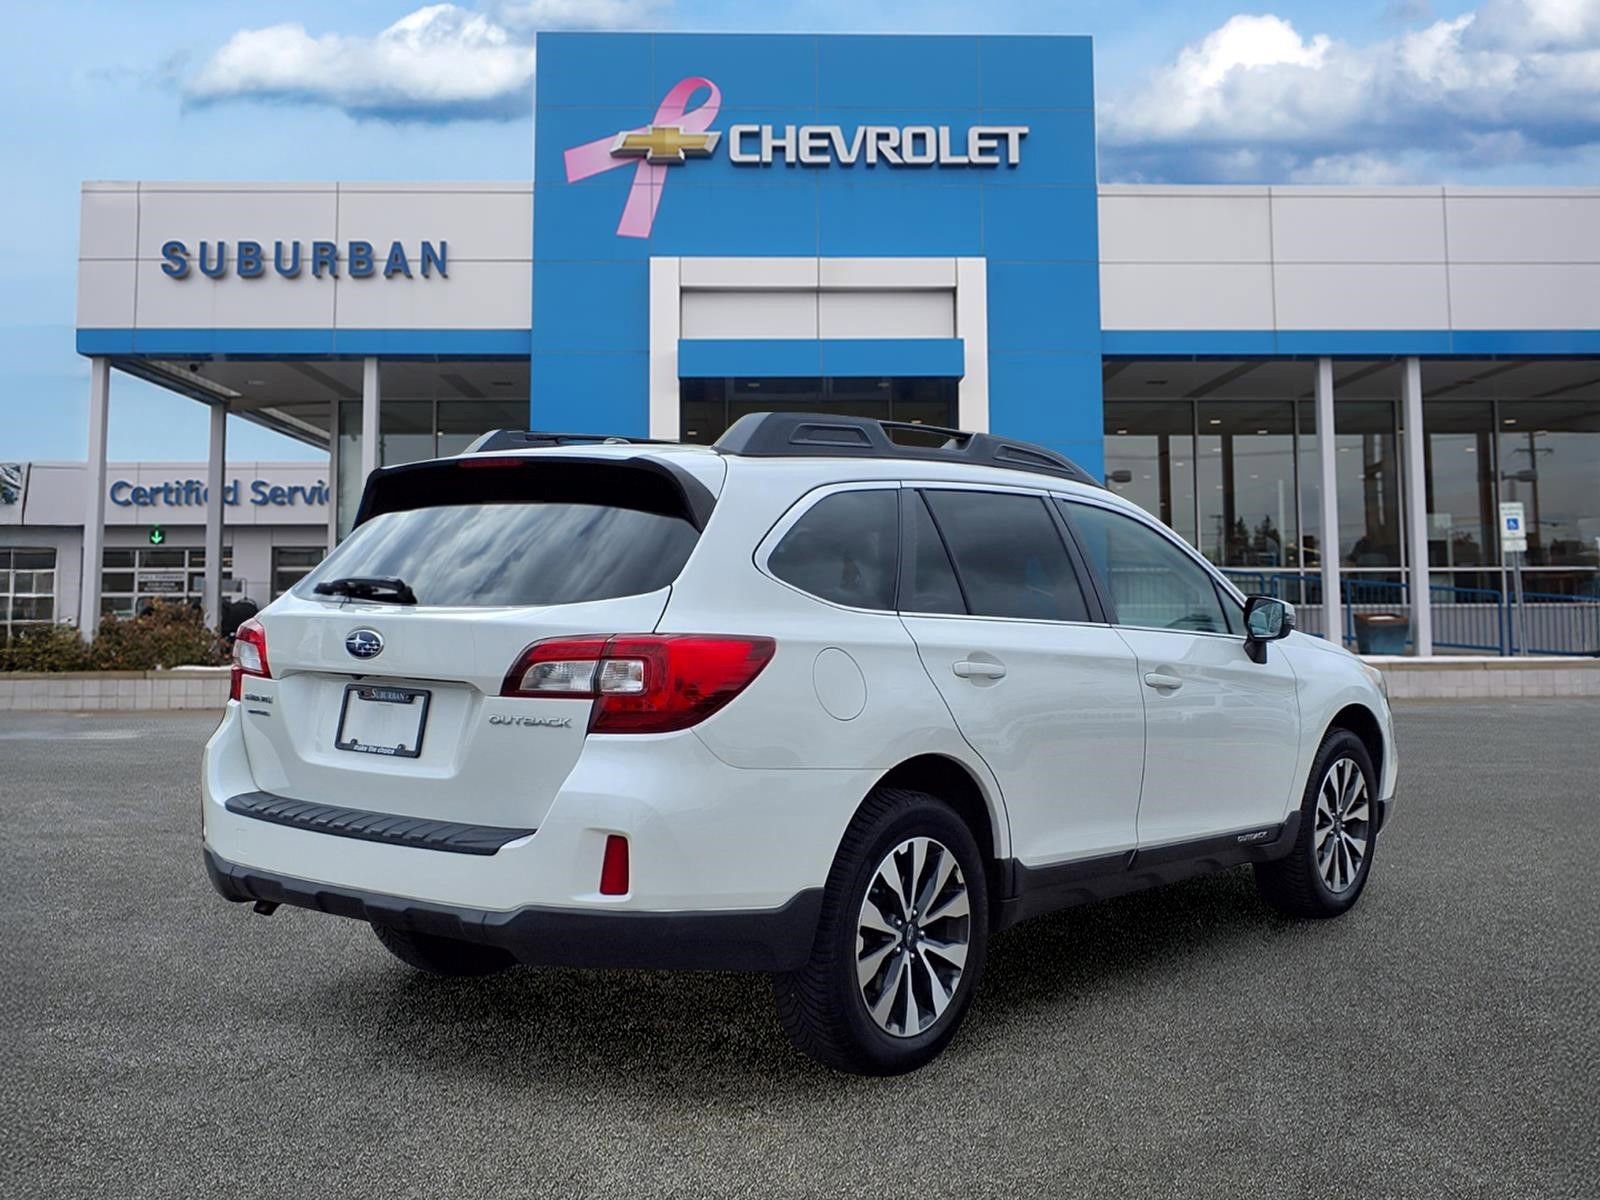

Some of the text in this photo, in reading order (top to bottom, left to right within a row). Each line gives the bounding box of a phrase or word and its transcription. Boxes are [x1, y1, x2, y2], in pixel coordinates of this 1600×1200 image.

[729, 124, 1029, 165] CHEVROLET
[160, 240, 448, 279] SUBURBAN
[249, 480, 329, 506] Servi
[488, 714, 572, 729] OUTBACK
